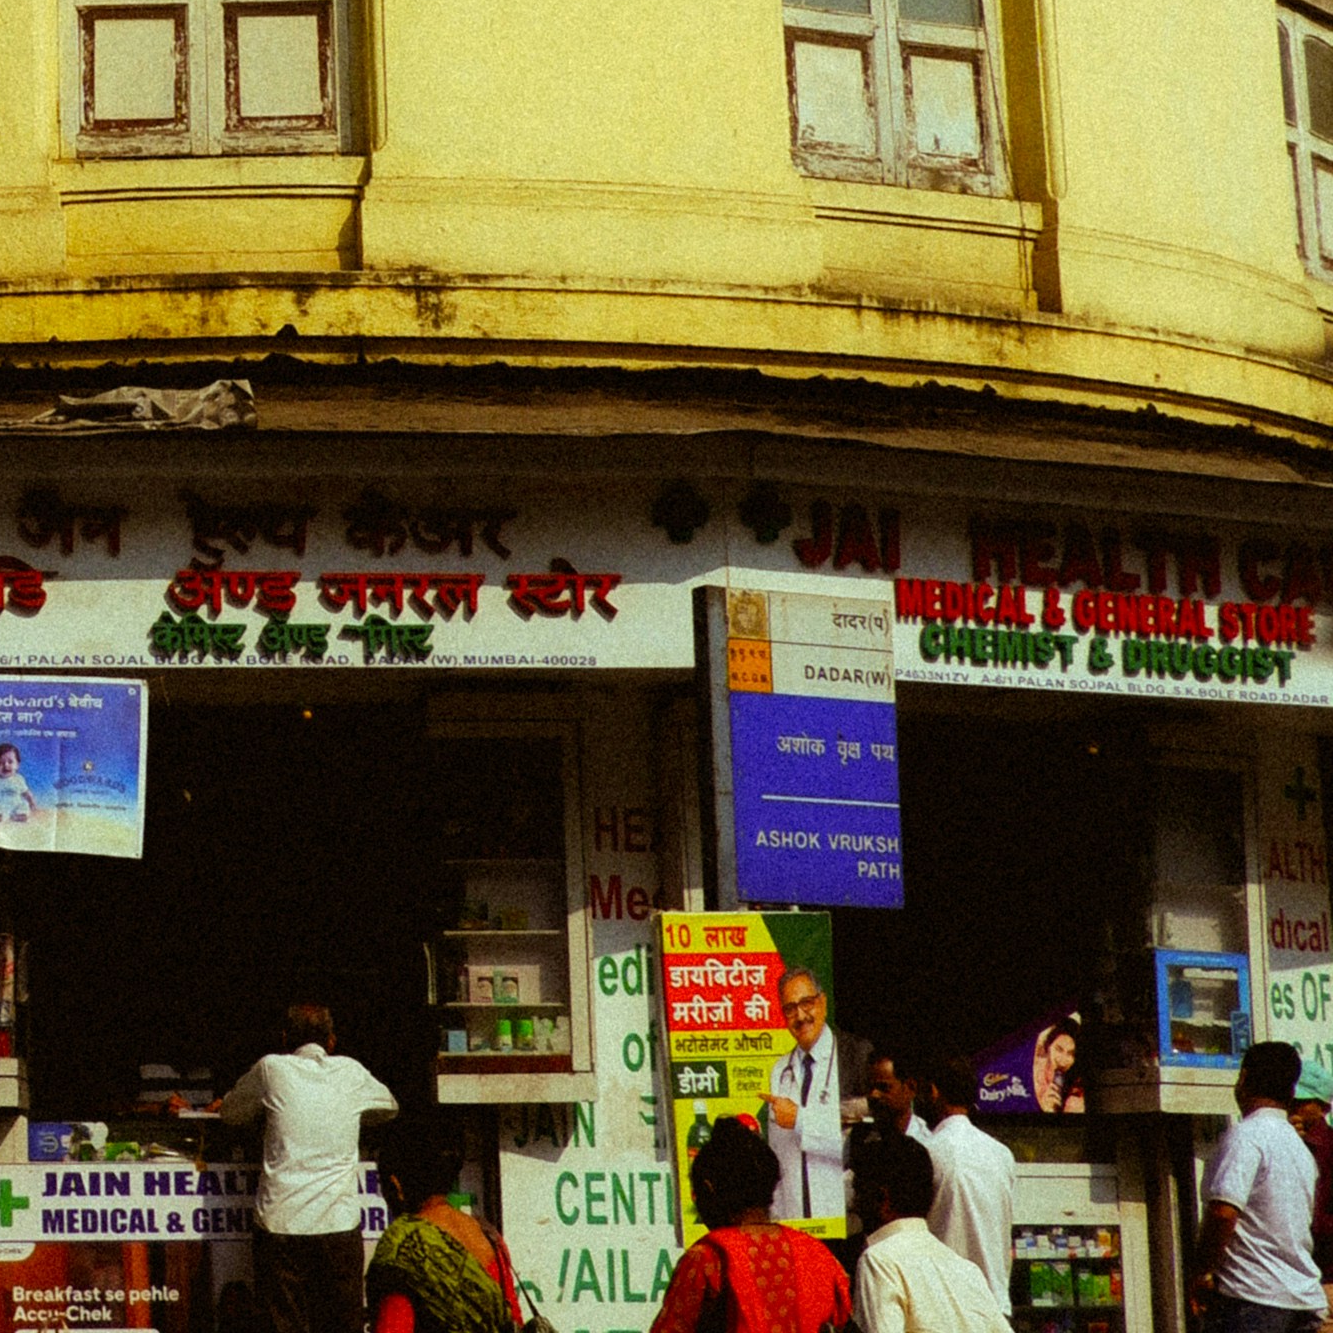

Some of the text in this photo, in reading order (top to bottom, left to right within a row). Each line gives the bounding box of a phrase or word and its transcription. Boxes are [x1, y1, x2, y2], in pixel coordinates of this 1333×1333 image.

[1238, 536, 1333, 611] CA
[317, 569, 485, 621] जनरल
[895, 577, 1033, 627] MEDICAL
[1042, 587, 1065, 627] &
[1073, 589, 1214, 639] GENERAL
[919, 623, 1294, 687] CHEMIST & DRUGGIST
[777, 734, 825, 757] अशोक
[870, 742, 895, 762] पथ
[756, 831, 898, 855] ASHOK VRUKSH
[857, 861, 900, 880] PATH
[666, 925, 748, 949] 10 लाख
[744, 993, 770, 1023] की
[41, 1170, 258, 1197] JAIN HEALT
[41, 1207, 159, 1235] MEDICAL
[167, 1212, 186, 1233] &
[12, 1285, 179, 1307] Breakfast se pehle
